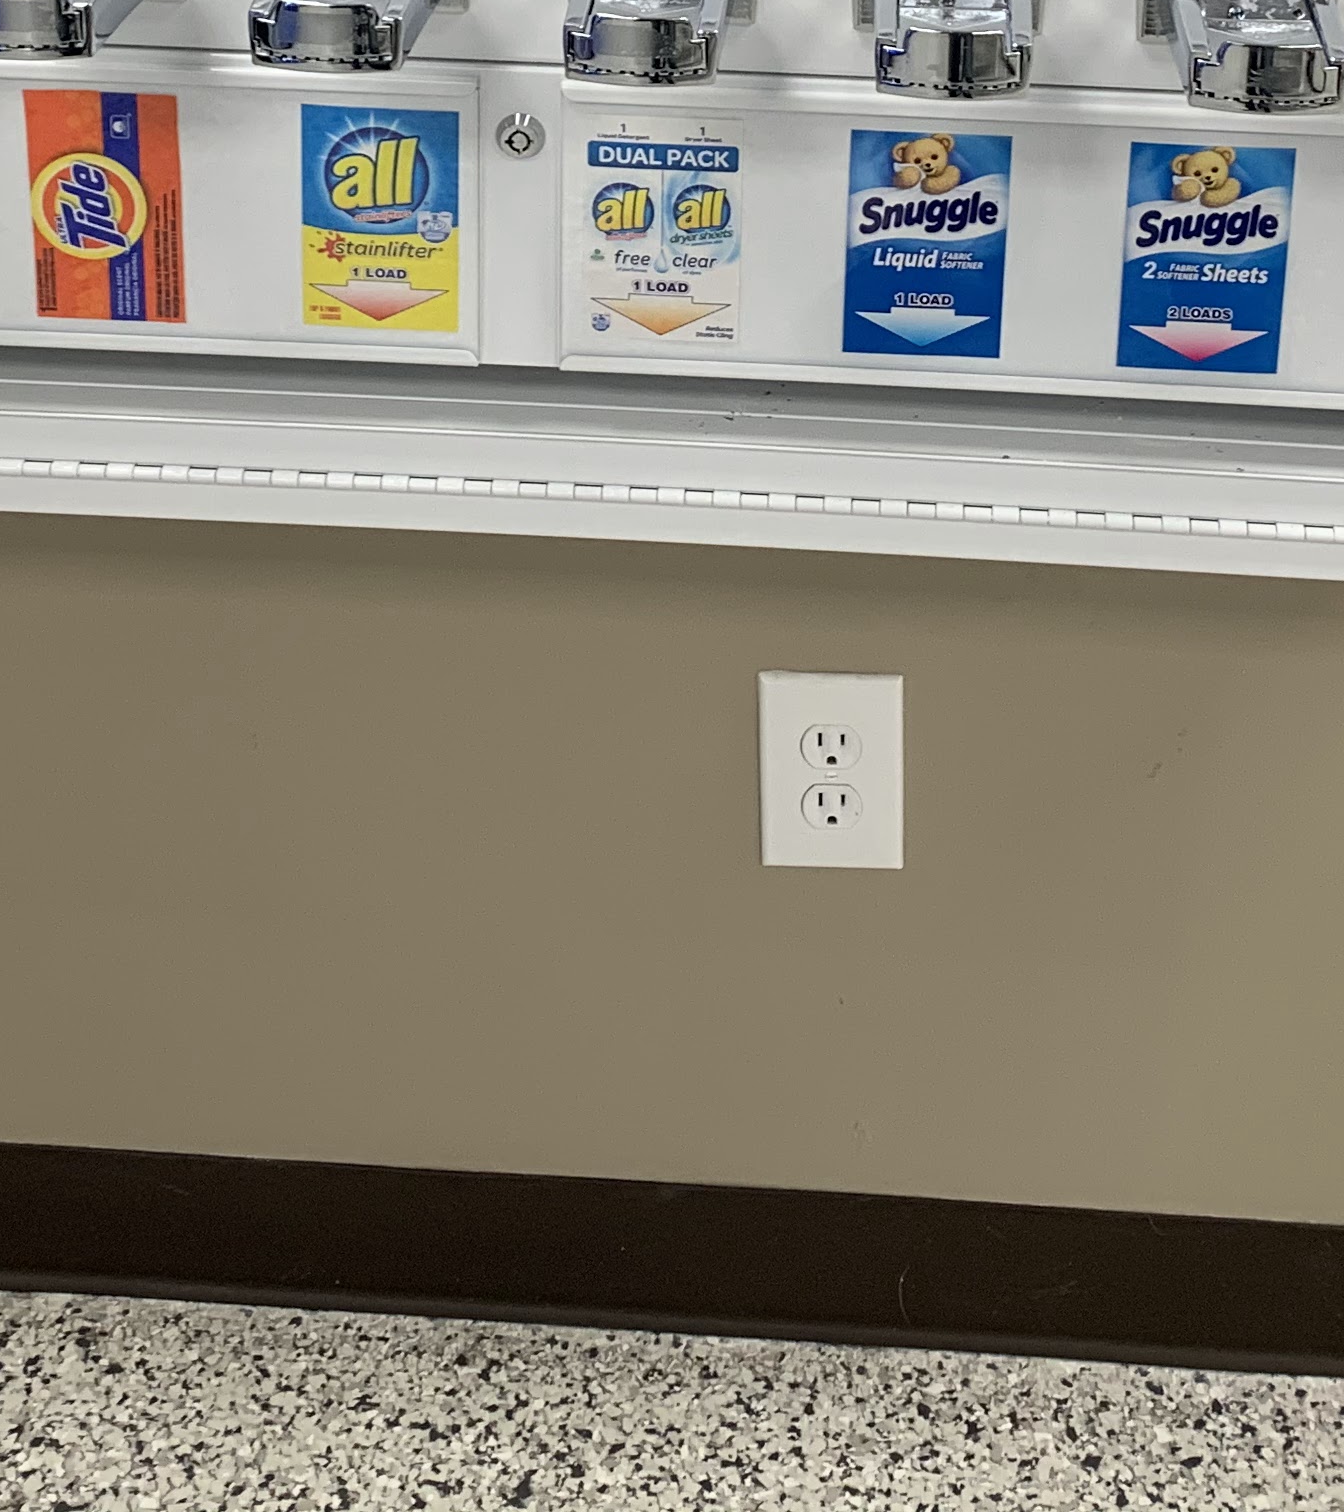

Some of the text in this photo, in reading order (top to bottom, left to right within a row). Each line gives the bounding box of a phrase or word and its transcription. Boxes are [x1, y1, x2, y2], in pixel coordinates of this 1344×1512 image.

[620, 123, 626, 133] 1
[700, 127, 705, 136] 1
[599, 146, 729, 168] DUAL PACK
[332, 137, 419, 209] all
[59, 163, 126, 248] Tide
[596, 187, 649, 231] all
[676, 188, 726, 230] all
[859, 191, 999, 234] Snuggle
[1136, 205, 1279, 248] Snuggle
[335, 240, 435, 259] stainlifter
[615, 250, 650, 266] free
[672, 253, 717, 268] clear
[873, 248, 939, 271] Liquid
[940, 261, 984, 270] SOFTENER
[352, 268, 407, 279] 1 LOAD
[1142, 261, 1157, 280] 2
[1201, 264, 1269, 284] Sheets
[634, 281, 688, 293] 1 LOAD
[895, 293, 953, 306] 1 LOAD
[1168, 306, 1233, 320] 2 LOADS
